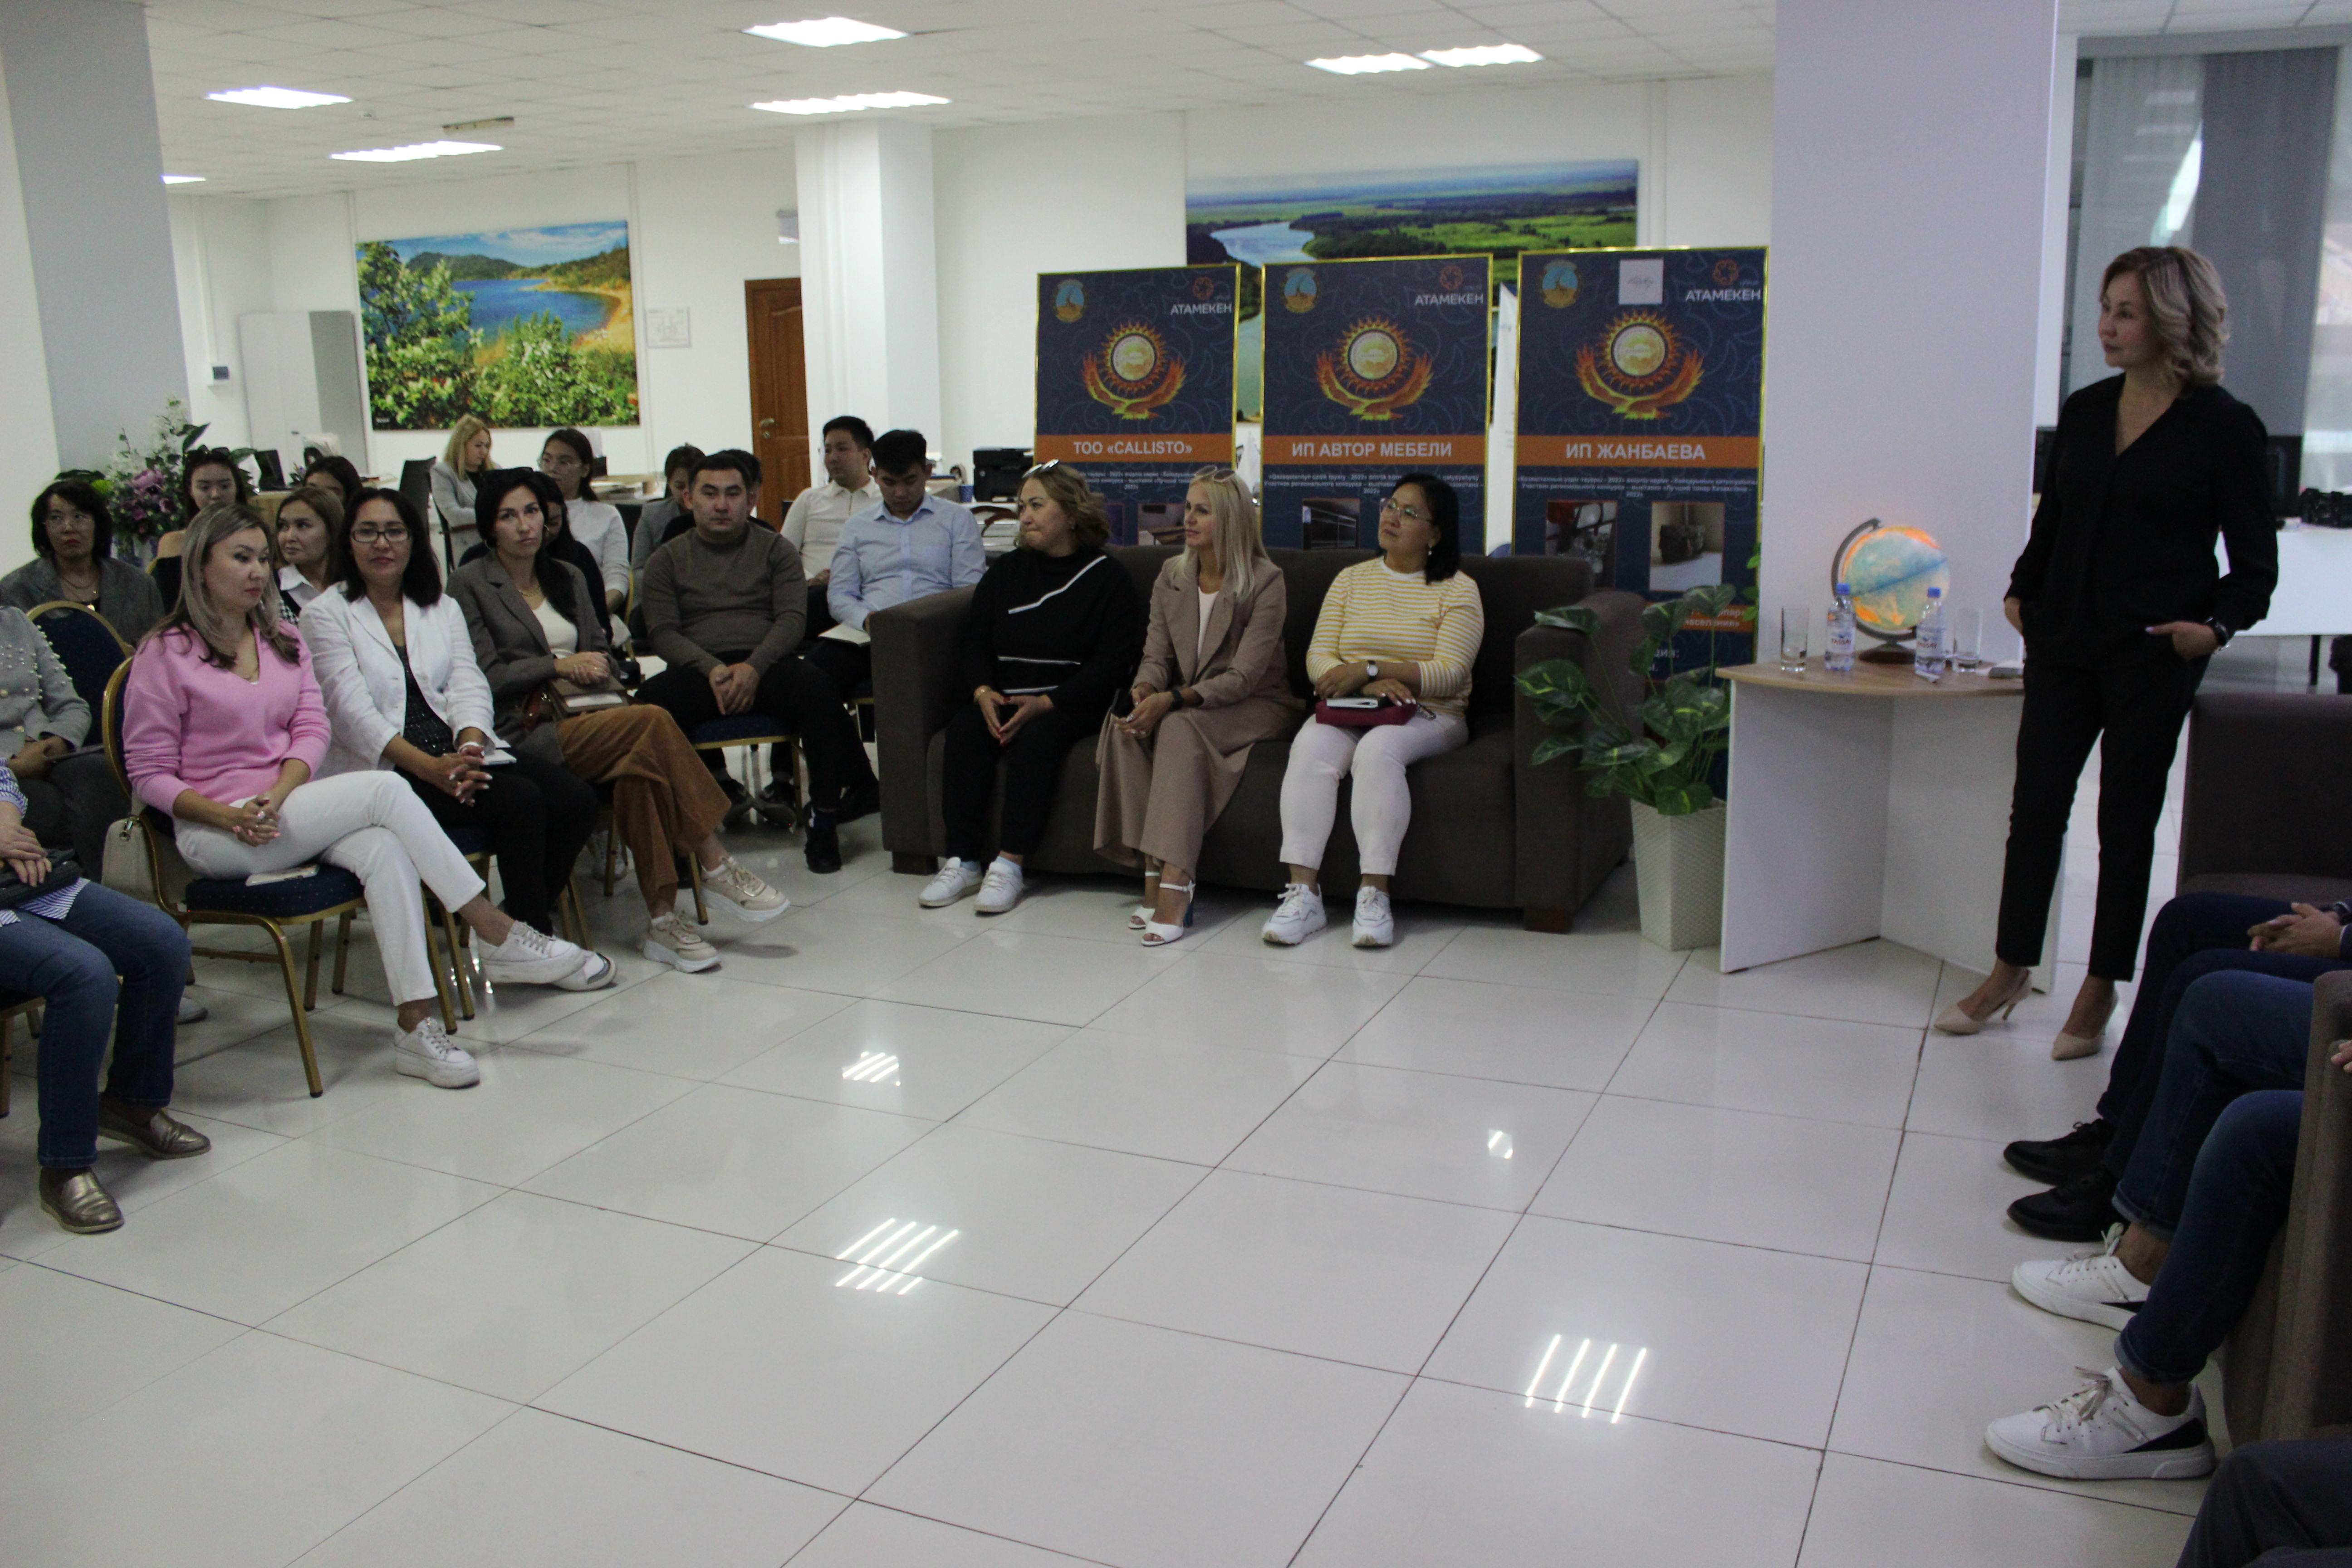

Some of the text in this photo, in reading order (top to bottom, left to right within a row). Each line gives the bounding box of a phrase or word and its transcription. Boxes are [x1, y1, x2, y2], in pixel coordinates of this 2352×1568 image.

[1414, 293, 1484, 306] АТАМЕКЕН
[1685, 289, 1761, 301] АТАМЕКЕН
[1171, 303, 1232, 315] АТАМЕКЕН
[1073, 441, 1192, 454] ТОО «CALLISTO»
[1293, 443, 1452, 456] ИП АВТОР МЕБЕЛИ
[1566, 443, 1706, 460] ИП ЖАНБАЕВА
